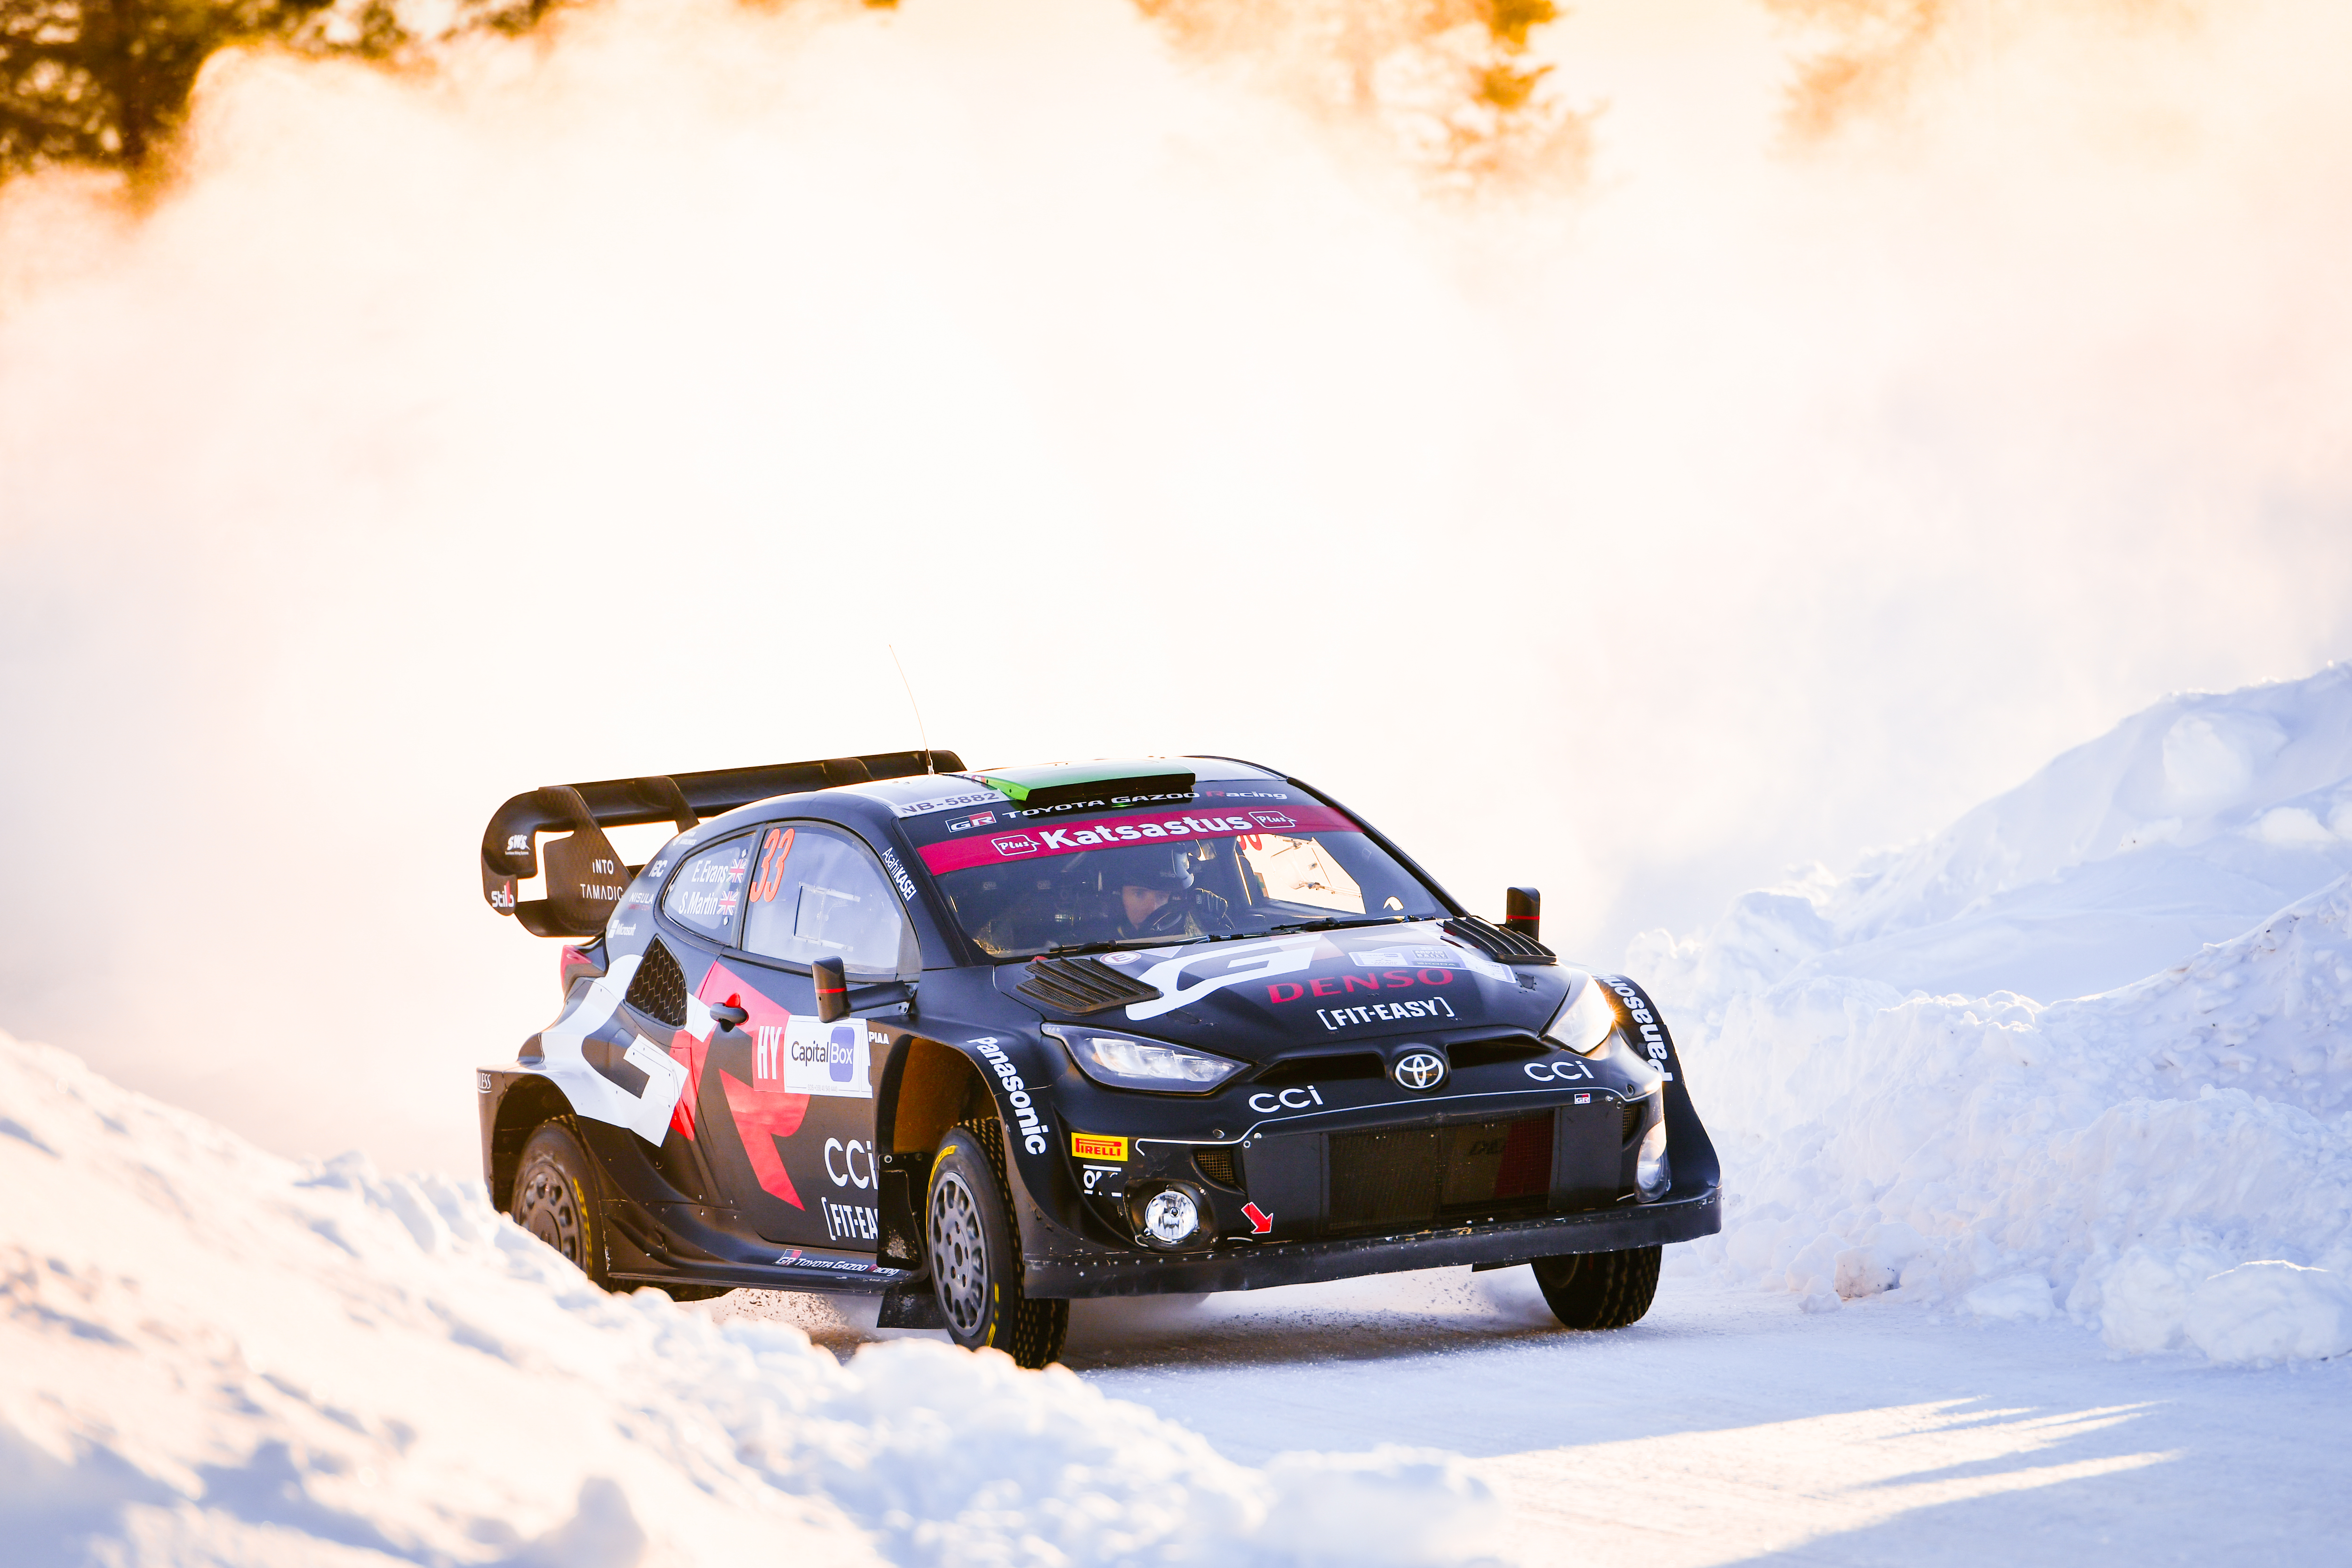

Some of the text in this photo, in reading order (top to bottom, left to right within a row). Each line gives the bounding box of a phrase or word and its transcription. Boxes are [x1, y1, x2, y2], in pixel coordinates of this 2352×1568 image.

[900, 792, 1000, 814] NB-5882
[950, 791, 1288, 831] GR TOYOTA GAZOO Racing
[507, 834, 530, 850] SWS
[998, 815, 1287, 850] Plus Katsastus Plus
[592, 859, 614, 875] INTO
[691, 860, 728, 883] E.Evans
[749, 828, 795, 902] 33
[580, 884, 624, 901] TAMADIC
[629, 892, 654, 904] NISULA
[678, 891, 719, 915] S.Martin
[615, 923, 636, 936] Microsoft
[1111, 954, 1130, 962] E
[1264, 968, 1453, 1004] DENSO
[868, 1031, 889, 1045] PIAA
[1590, 973, 1673, 1082] Panasonic
[758, 1025, 782, 1080] HY
[477, 1072, 491, 1089] LESS
[967, 1036, 1049, 1155] Panasonic
[1075, 1138, 1122, 1156] PIRELLI
[821, 1196, 878, 1241] [FIT-EA
[776, 1257, 797, 1265] GR
[794, 1258, 834, 1268] TOYOTA
